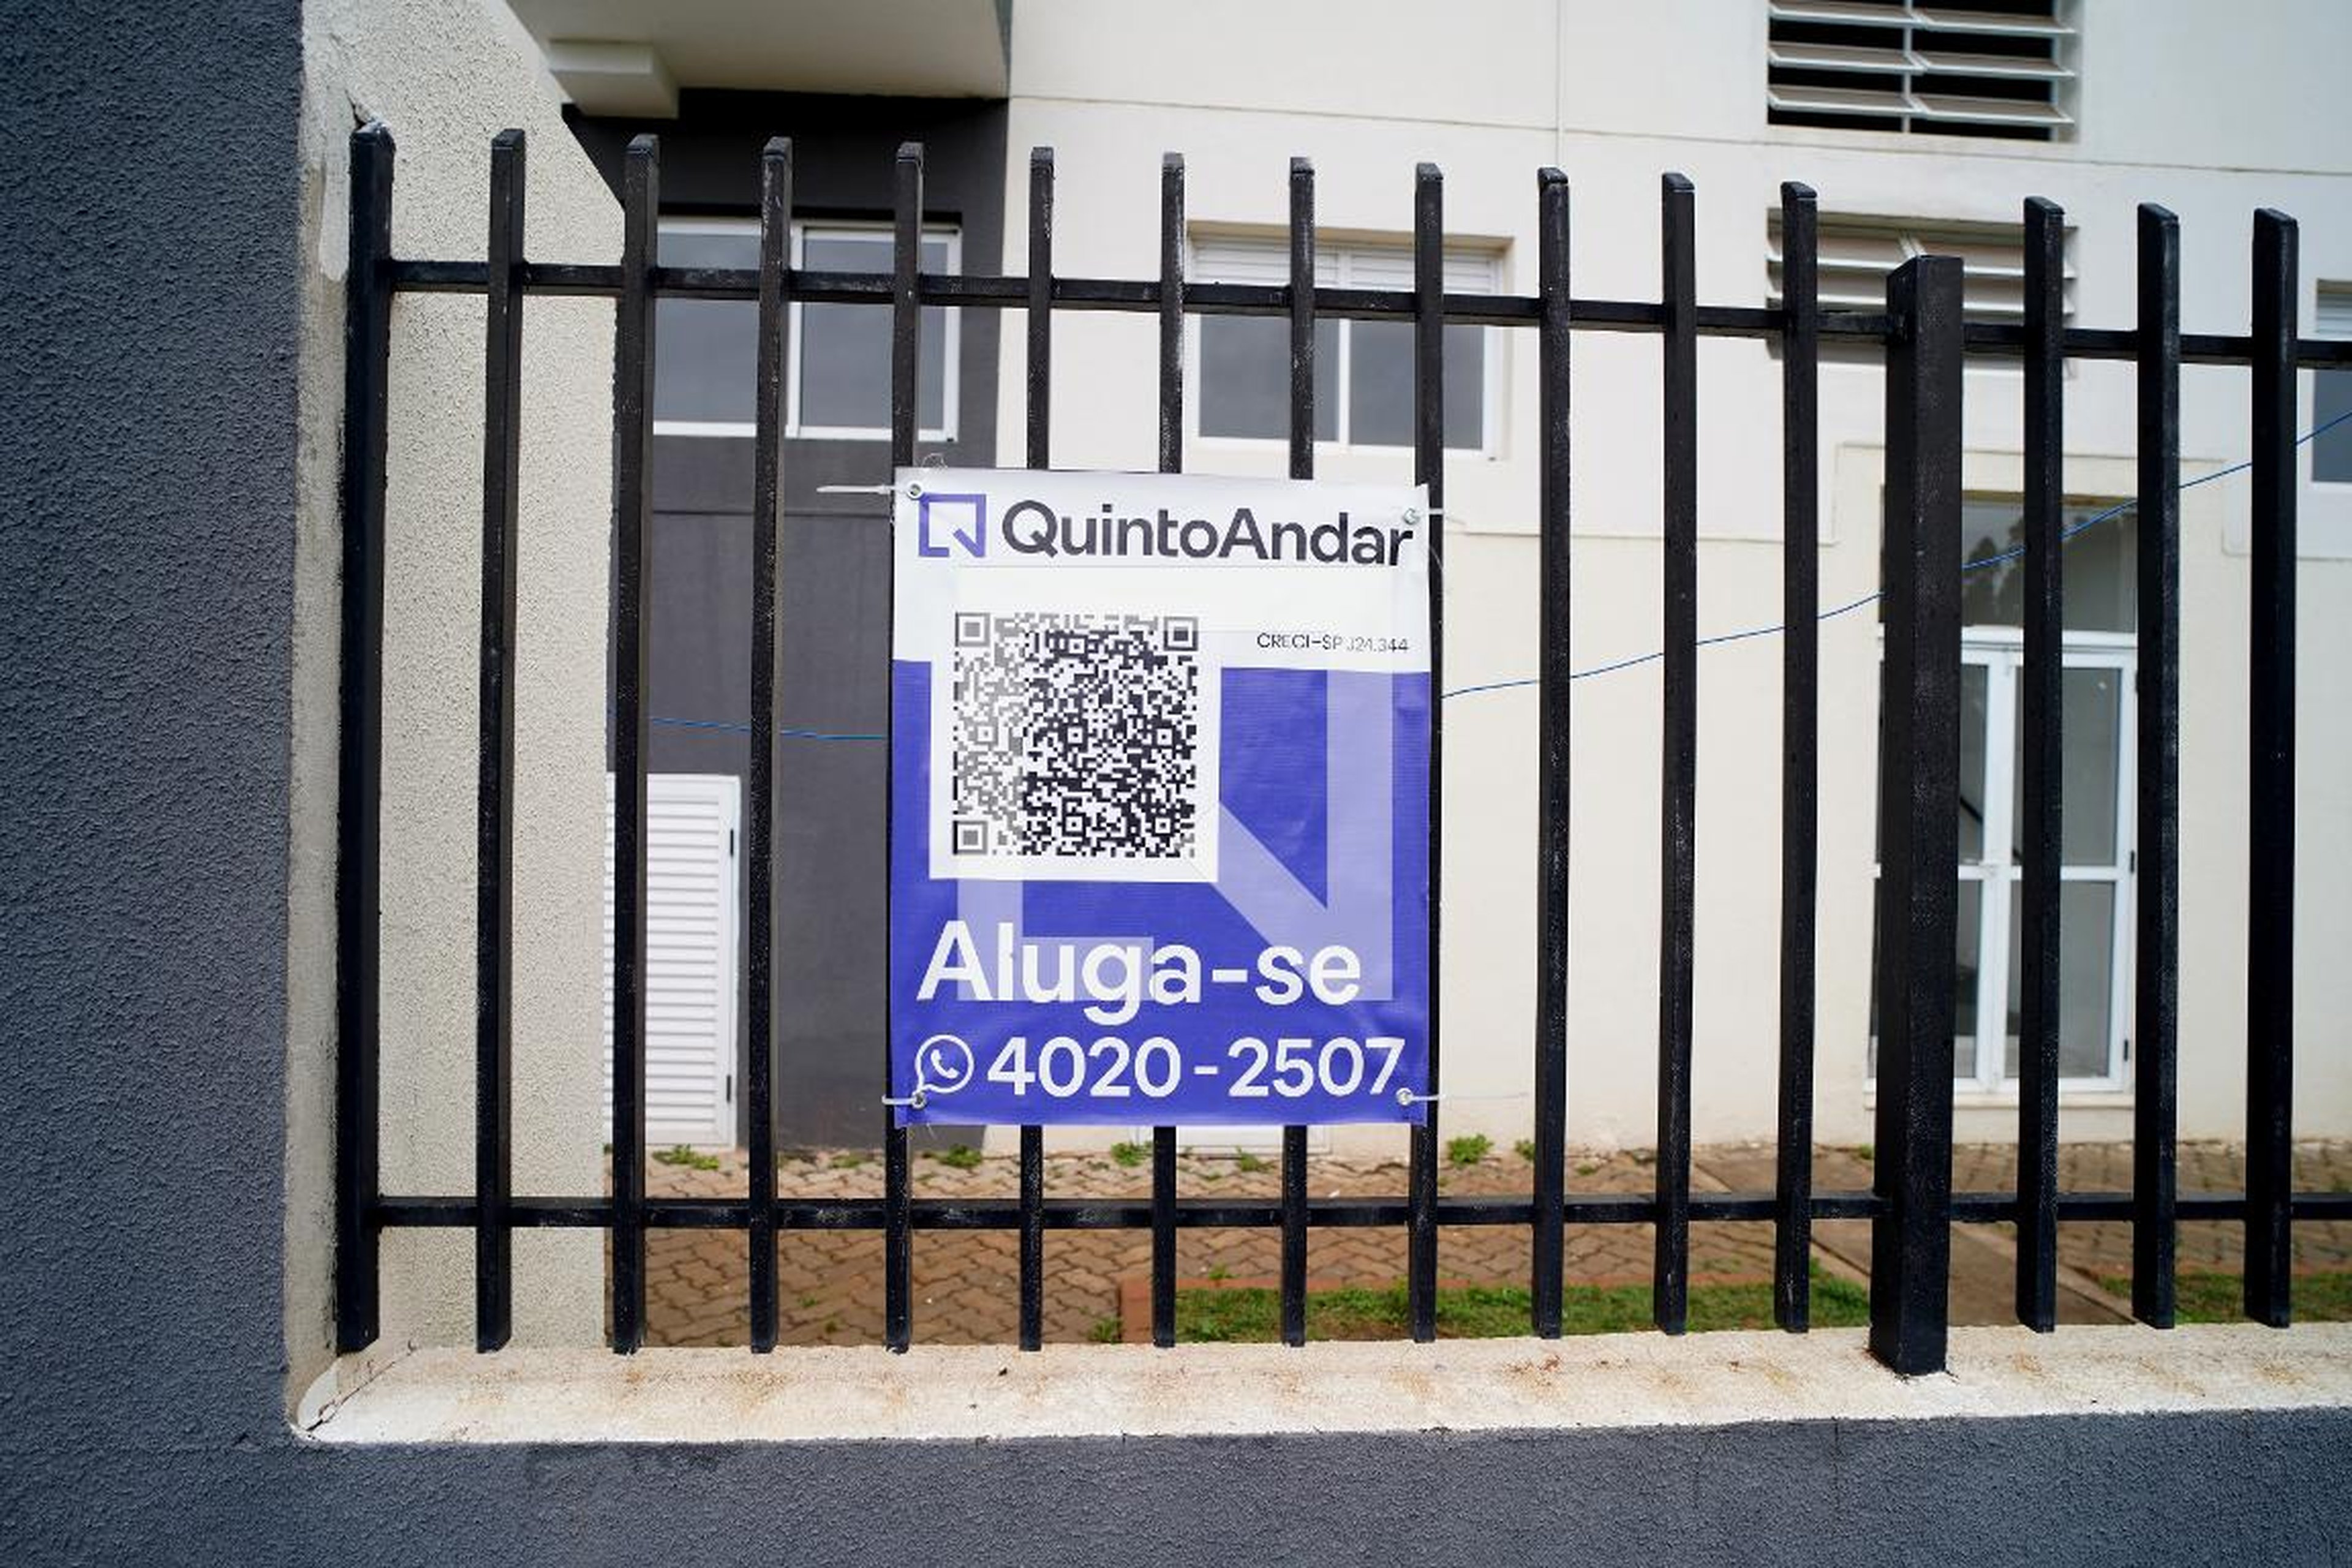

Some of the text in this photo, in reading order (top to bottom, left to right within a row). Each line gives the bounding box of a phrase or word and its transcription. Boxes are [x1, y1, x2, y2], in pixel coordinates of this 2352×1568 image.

[1001, 499, 1414, 566] QuintoAndar
[1256, 632, 1343, 650] CRECI-SP
[916, 920, 1362, 1026] Aluga-se
